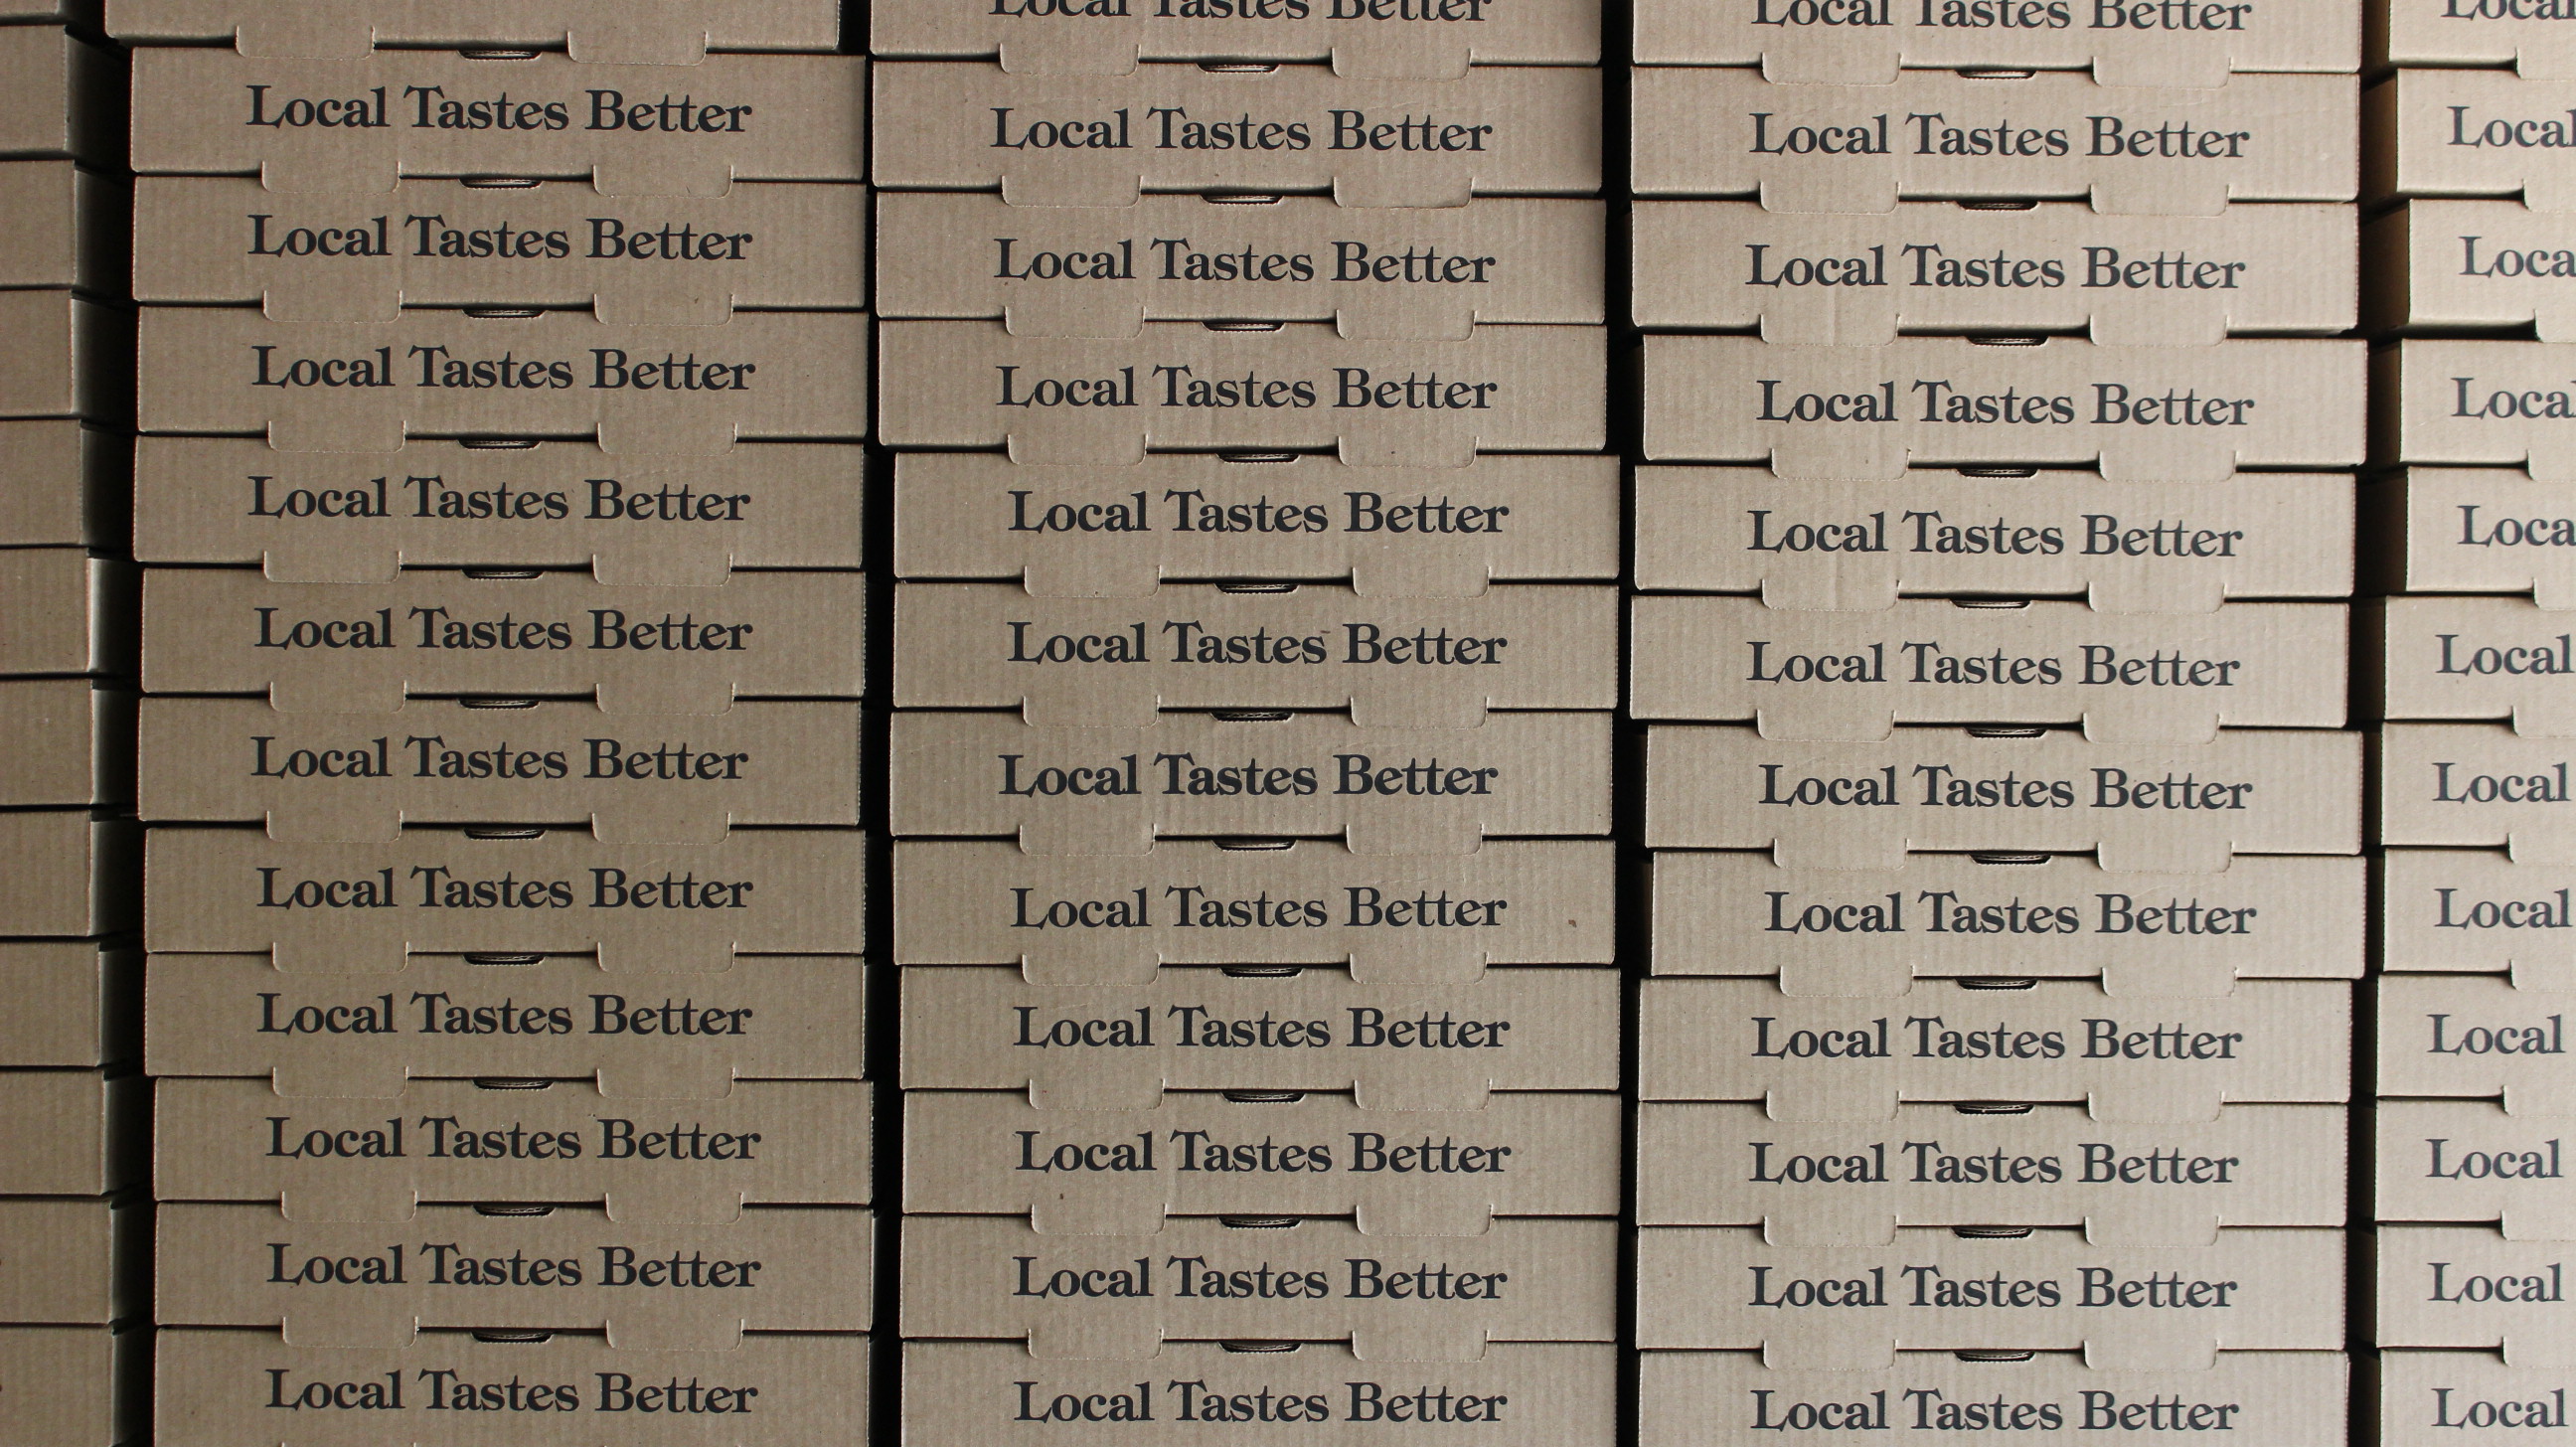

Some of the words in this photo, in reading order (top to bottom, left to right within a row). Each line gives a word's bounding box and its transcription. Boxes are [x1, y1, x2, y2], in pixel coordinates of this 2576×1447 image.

[1750, 0, 1894, 28] Local
[2087, 0, 2252, 31] Better
[244, 84, 392, 129] Local
[402, 84, 569, 131] Tastes
[584, 89, 753, 133] Better
[989, 107, 1134, 151] Local
[1146, 105, 1312, 151] Tastes
[1327, 109, 1494, 152] Better
[1748, 112, 1892, 157] Local
[1904, 111, 2069, 157] Tastes
[2085, 115, 2250, 159] Better
[246, 214, 393, 258] Local
[403, 214, 570, 259] Tastes
[584, 218, 753, 261] Better
[993, 238, 1137, 282] Local
[1149, 237, 1315, 282] Tastes
[1330, 241, 1497, 284] Better
[1744, 243, 1889, 289] Local
[1900, 242, 2065, 288] Tastes
[2080, 246, 2246, 290] Better
[250, 345, 397, 390] Local
[407, 344, 574, 390] Tastes
[588, 348, 756, 392] Better
[995, 365, 1140, 409] Local
[1151, 364, 1317, 408] Tastes
[1332, 368, 1498, 409] Better
[1755, 380, 1899, 424] Local
[1910, 379, 2075, 424] Tastes
[2089, 383, 2255, 426] Better
[2450, 377, 2576, 420] Loca
[246, 475, 393, 520] Local
[402, 474, 569, 520] Tastes
[583, 479, 751, 522] Better
[1007, 490, 1152, 535] Local
[1163, 488, 1329, 534] Tastes
[1343, 491, 1511, 534] Better
[1746, 510, 1889, 555] Local
[1900, 509, 2064, 556] Tastes
[2079, 514, 2244, 558] Better
[253, 607, 398, 651] Local
[407, 605, 572, 651] Tastes
[586, 609, 754, 652] Better
[1006, 621, 1151, 666] Local
[1162, 619, 1328, 665] Tastes
[1342, 623, 1509, 666] Better
[1745, 641, 1888, 686] Local
[1899, 640, 2062, 686] Tastes
[2077, 645, 2241, 687] Better
[2435, 633, 2575, 677] Local
[249, 735, 394, 780] Local
[403, 734, 568, 780] Tastes
[582, 738, 749, 781] Better
[997, 753, 1143, 799] Local
[1153, 751, 1319, 797] Tastes
[1332, 753, 1499, 796] Better
[1758, 763, 1900, 808] Local
[1911, 763, 2075, 809] Tastes
[2089, 767, 2253, 810] Better
[2431, 761, 2571, 805] Local
[255, 867, 400, 910] Local
[409, 865, 574, 909] Tastes
[587, 868, 754, 909] Better
[1009, 886, 1153, 930] Local
[1164, 884, 1328, 928] Tastes
[1343, 886, 1508, 927] Better
[2434, 887, 2573, 930] Local
[1763, 890, 1906, 935] Local
[1917, 889, 2080, 934] Tastes
[2094, 893, 2257, 935] Better
[255, 992, 399, 1037] Local
[409, 991, 573, 1036] Tastes
[587, 994, 753, 1036] Better
[1012, 1006, 1156, 1049] Local
[1167, 1004, 1332, 1048] Tastes
[1346, 1007, 1511, 1048] Better
[2426, 1014, 2566, 1056] Local
[1750, 1017, 1892, 1060] Local
[1903, 1015, 2066, 1059] Tastes
[2080, 1018, 2243, 1060] Better
[264, 1116, 407, 1160] Local
[418, 1115, 582, 1160] Tastes
[596, 1118, 762, 1161] Better
[1015, 1130, 1158, 1174] Local
[1169, 1128, 1333, 1173] Tastes
[1347, 1132, 1513, 1174] Better
[2425, 1138, 2564, 1181] Local
[1747, 1142, 1890, 1186] Local
[1900, 1140, 2062, 1184] Tastes
[2076, 1143, 2239, 1185] Better
[265, 1242, 408, 1287] Local
[418, 1241, 582, 1287] Tastes
[596, 1245, 762, 1288] Better
[1012, 1255, 1155, 1300] Local
[1166, 1254, 1330, 1299] Tastes
[1343, 1258, 1509, 1300] Better
[1747, 1265, 1889, 1310] Local
[1900, 1264, 2061, 1308] Tastes
[2076, 1266, 2238, 1309] Better
[2427, 1262, 2565, 1305] Local
[264, 1368, 406, 1412] Local
[417, 1367, 580, 1412] Tastes
[594, 1371, 759, 1414] Better
[1013, 1380, 1156, 1424] Local
[1166, 1378, 1330, 1423] Tastes
[1344, 1381, 1509, 1423] Better
[1749, 1389, 1891, 1433] Local
[1901, 1387, 2063, 1431] Tastes
[2077, 1389, 2240, 1431] Better
[2430, 1387, 2569, 1430] Local
